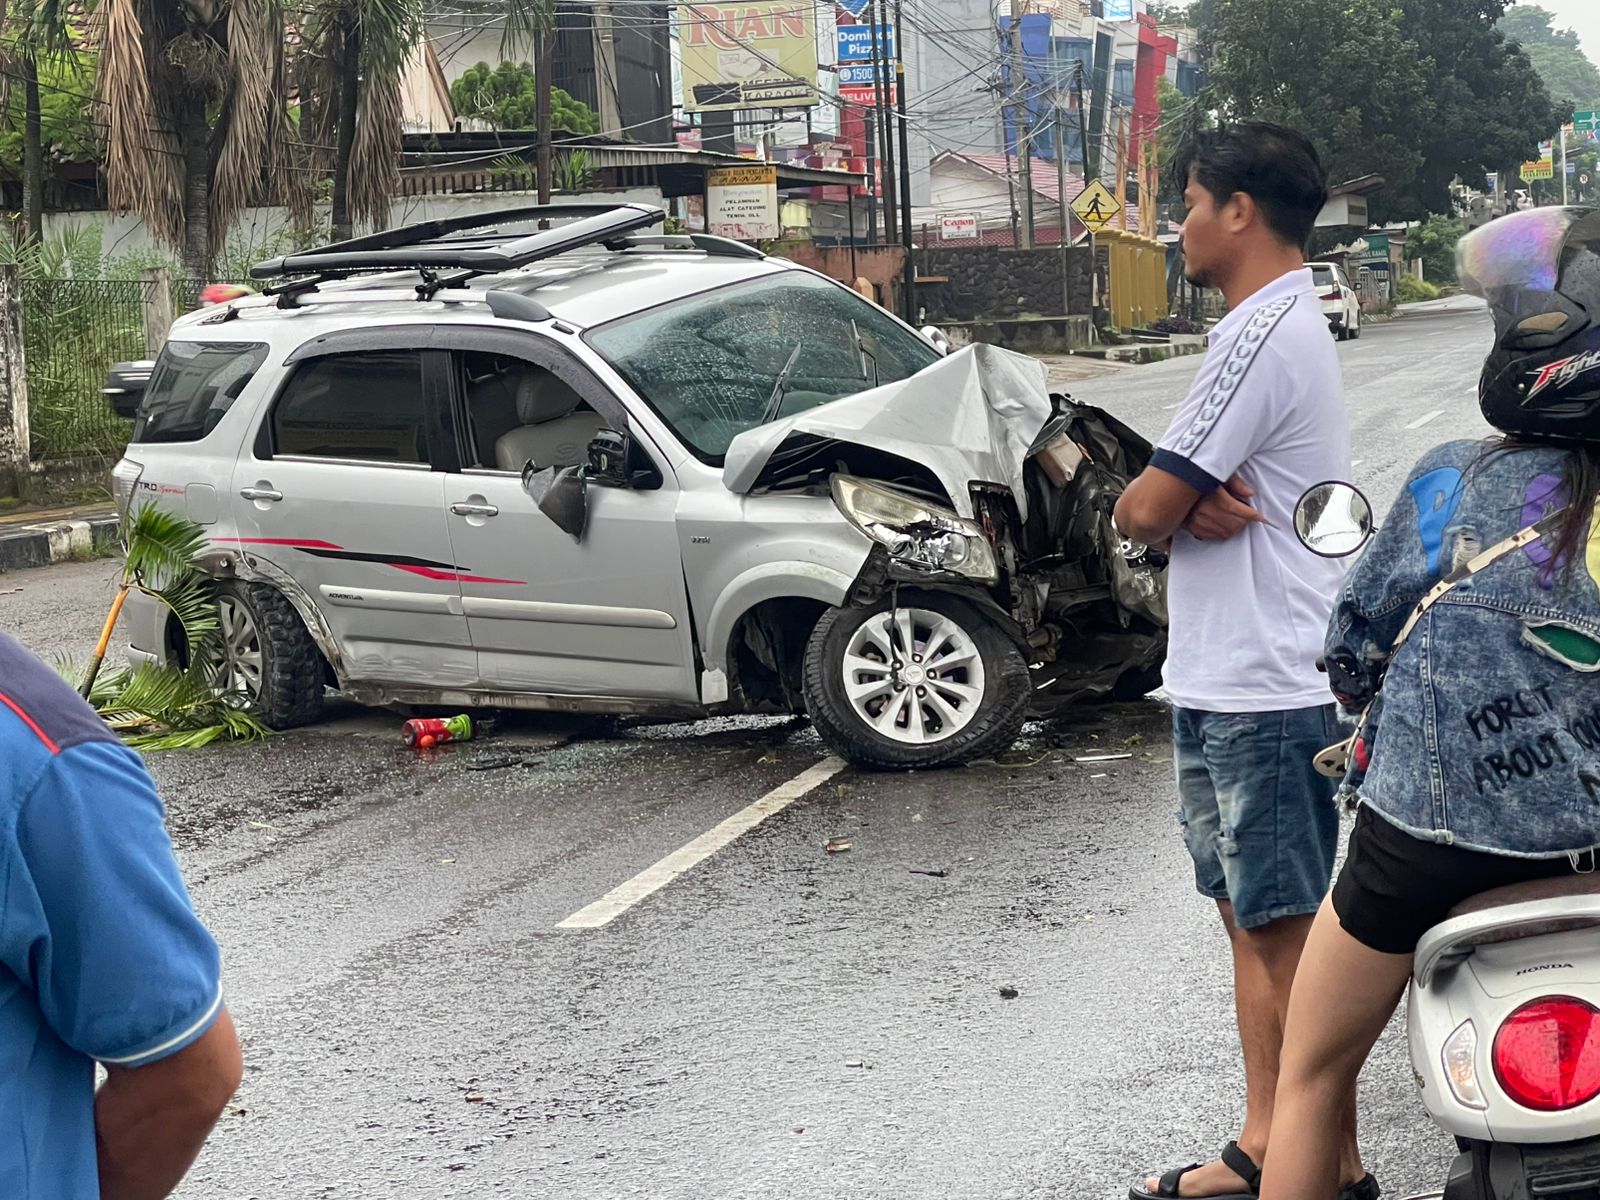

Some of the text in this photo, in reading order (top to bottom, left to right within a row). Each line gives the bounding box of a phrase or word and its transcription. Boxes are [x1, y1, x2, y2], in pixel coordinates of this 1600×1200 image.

[686, 4, 807, 51] RIAN
[838, 30, 892, 42] Domios
[851, 67, 873, 80] 1500
[743, 88, 815, 101] KARAOKE
[839, 91, 894, 102] DELIVEY
[139, 481, 158, 491] TRD
[1472, 728, 1569, 795] ABOUT
[1516, 963, 1574, 976] HONDA
